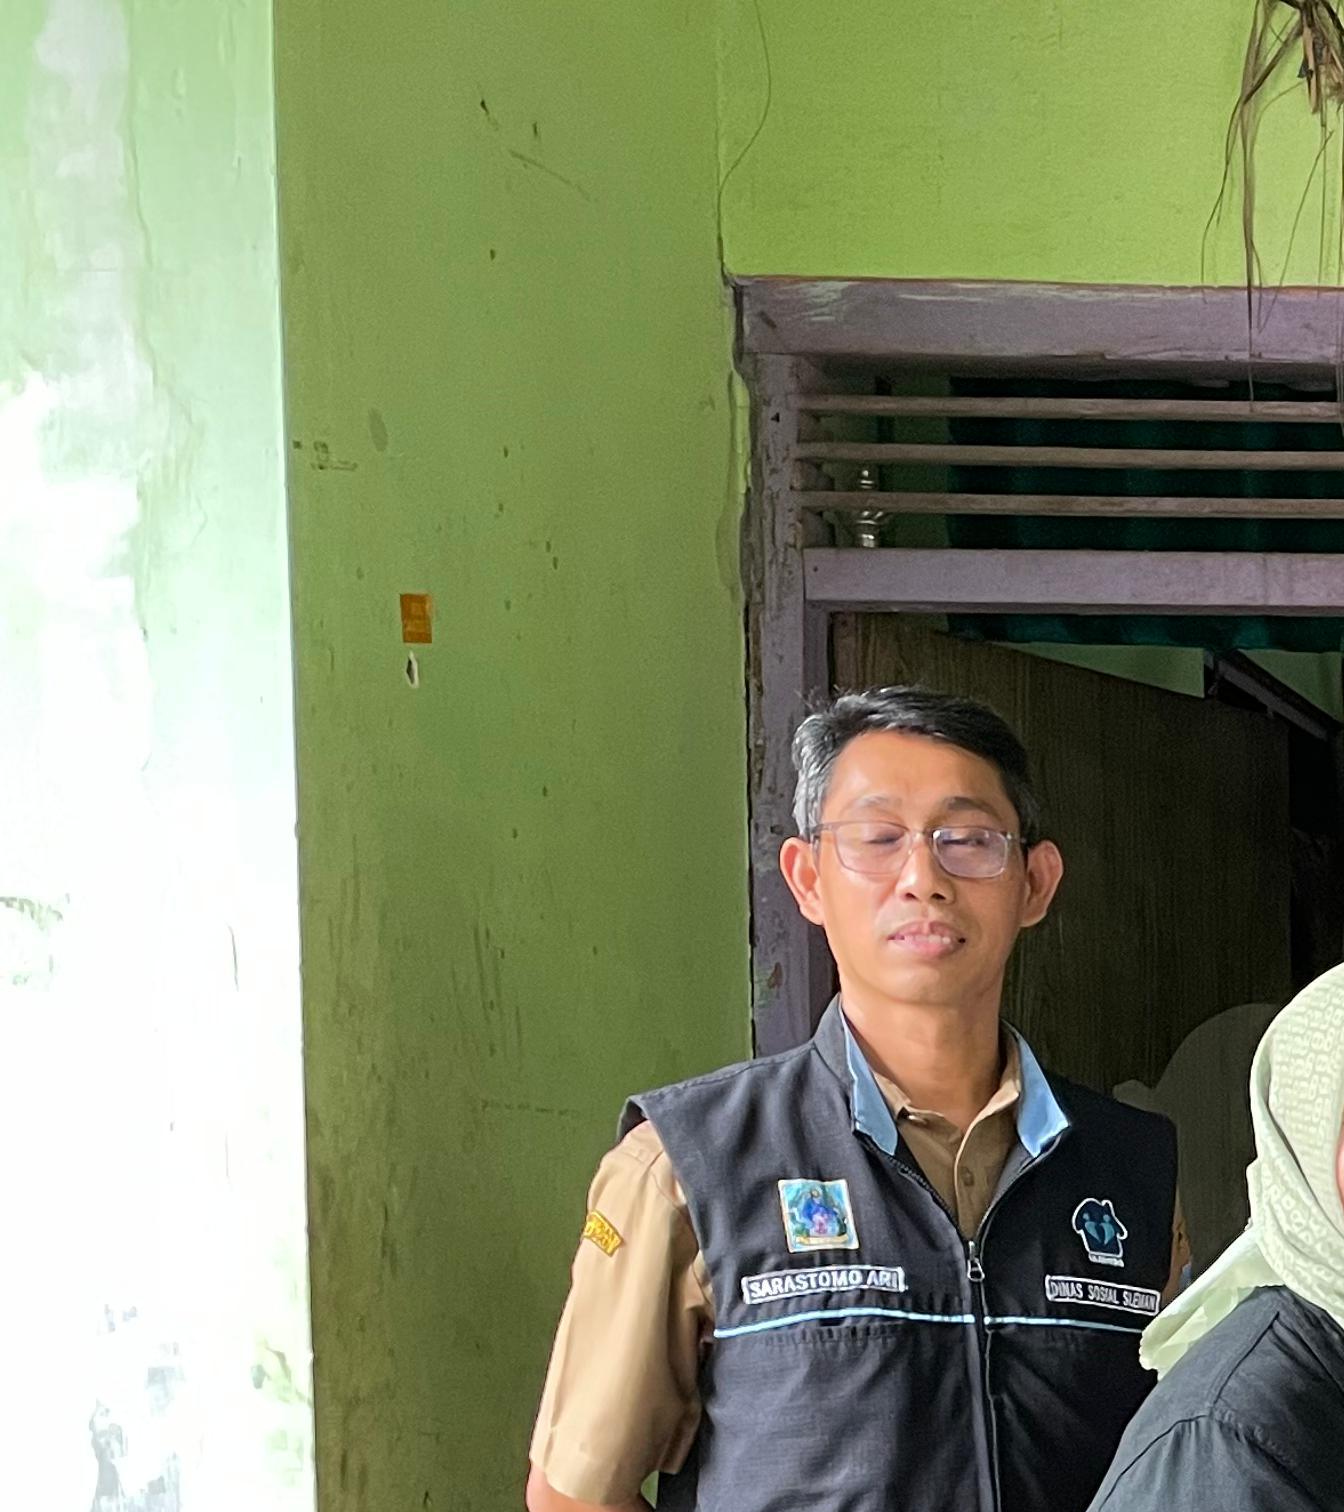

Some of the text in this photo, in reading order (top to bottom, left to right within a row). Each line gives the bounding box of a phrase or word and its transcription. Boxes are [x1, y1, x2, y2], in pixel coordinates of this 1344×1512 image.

[750, 1269, 898, 1298] SARASTOMO ARI
[1050, 1281, 1156, 1311] DINAS SOSIAL SLEMAN
